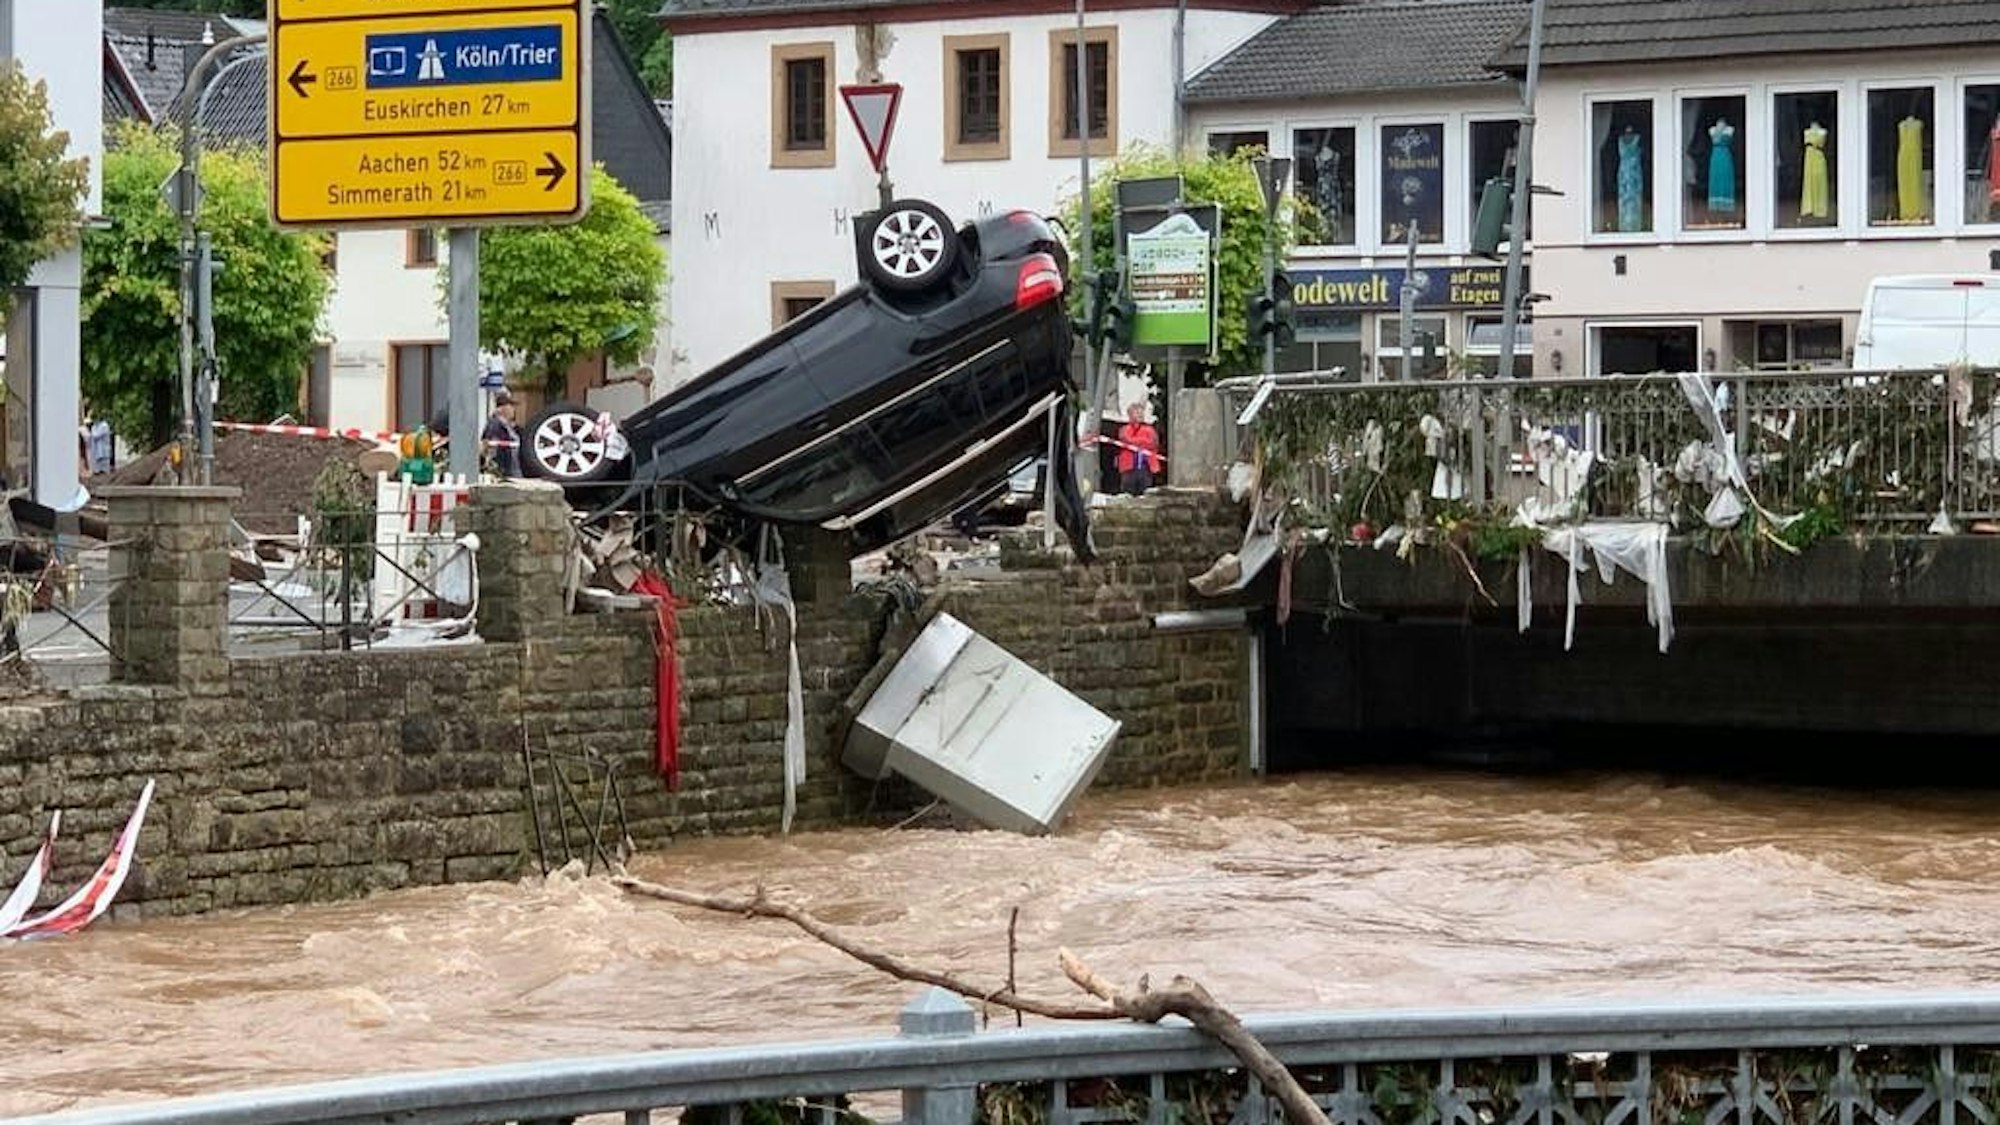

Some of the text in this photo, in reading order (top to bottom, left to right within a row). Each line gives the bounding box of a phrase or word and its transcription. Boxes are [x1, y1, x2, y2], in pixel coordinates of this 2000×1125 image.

[384, 53, 392, 70] 1
[456, 43, 557, 69] Köln/Trier
[327, 70, 353, 87] 266
[364, 94, 530, 121] Euskirchen 27 km
[359, 150, 487, 174] Aachen 52 km
[497, 165, 523, 181] 266
[328, 180, 487, 205] Simmerath 21 km
[1450, 268, 1501, 285] auf zwei
[1293, 274, 1389, 305] odewelt
[1450, 284, 1500, 305] Etagen
